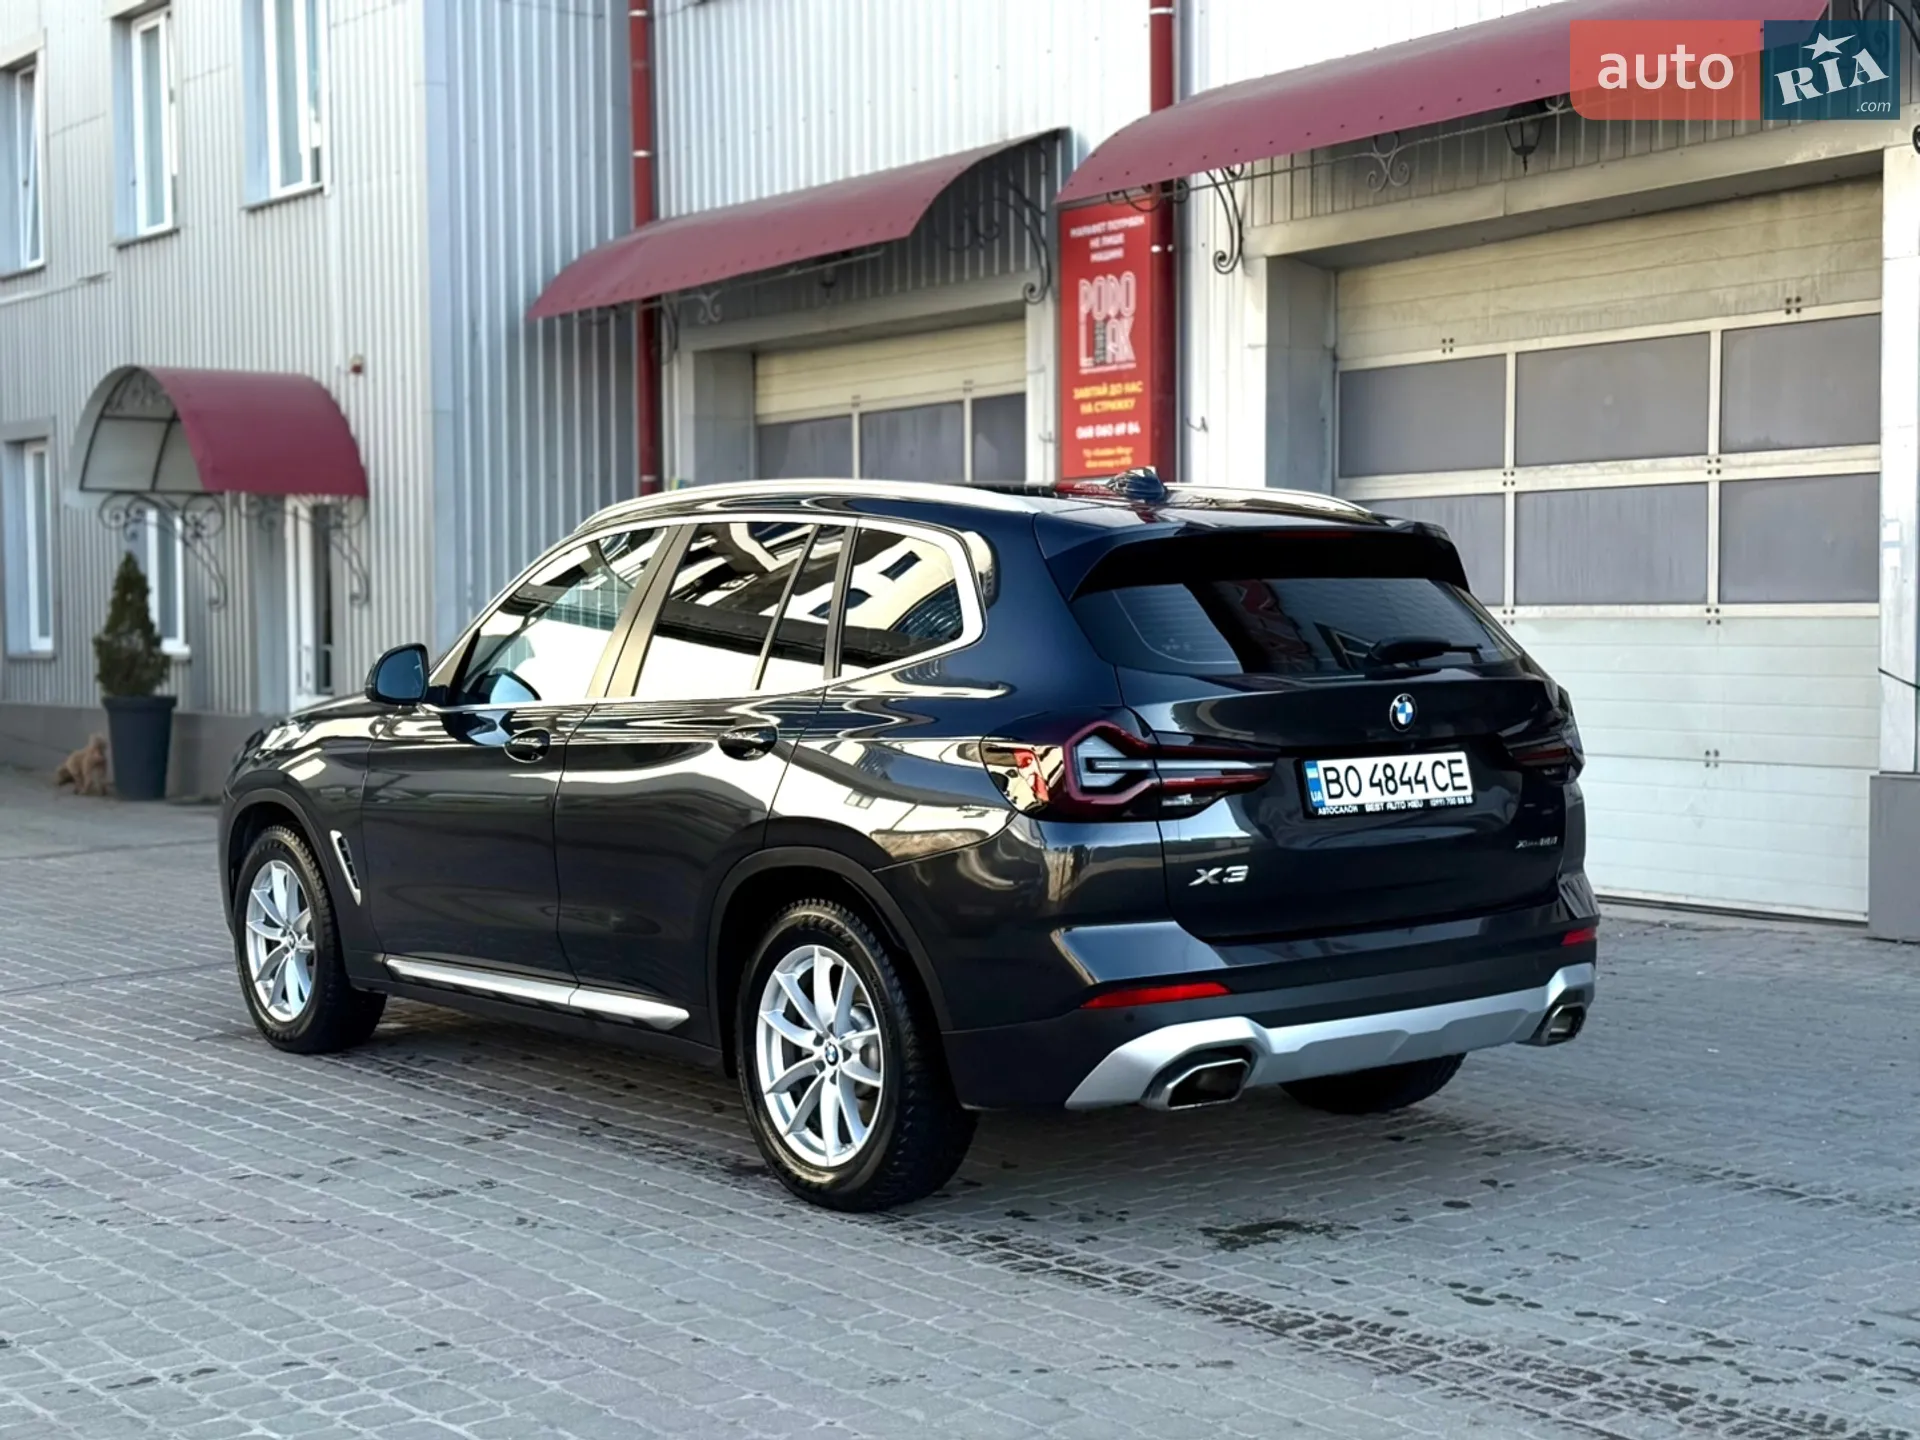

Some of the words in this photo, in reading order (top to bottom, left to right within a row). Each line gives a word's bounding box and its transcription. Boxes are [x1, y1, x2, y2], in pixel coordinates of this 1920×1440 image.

[1322, 765, 1363, 800] BO
[1369, 761, 1429, 796] 4844
[1431, 758, 1468, 793] CE
[1310, 790, 1323, 803] UA
[1188, 865, 1250, 887] X3
